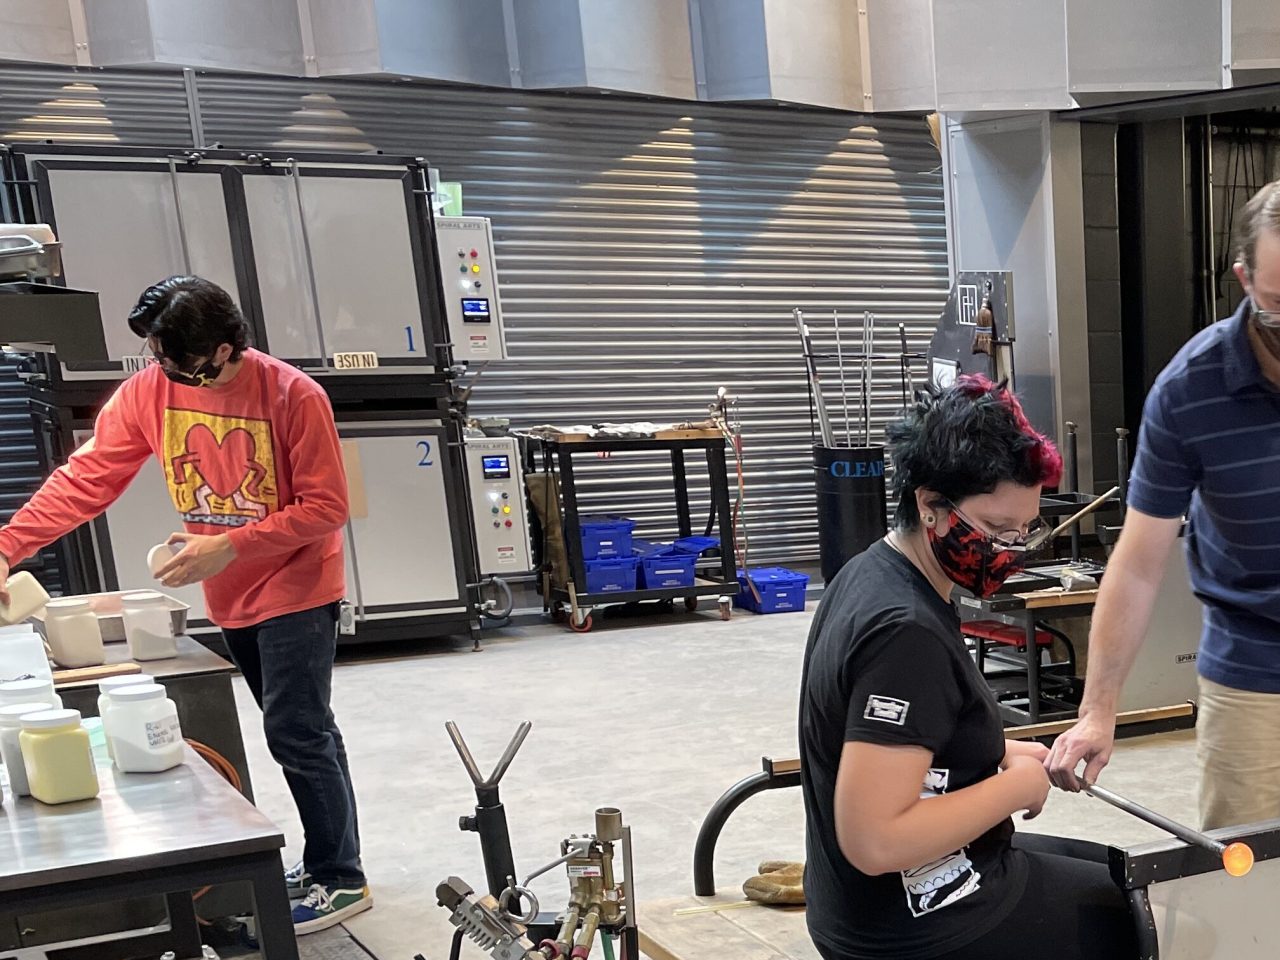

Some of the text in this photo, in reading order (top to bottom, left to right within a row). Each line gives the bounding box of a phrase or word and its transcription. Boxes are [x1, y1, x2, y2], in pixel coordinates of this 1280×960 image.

[404, 325, 417, 352] 1
[336, 354, 375, 368] IN USE
[416, 441, 433, 466] 2
[1176, 654, 1197, 662] SPIRA
